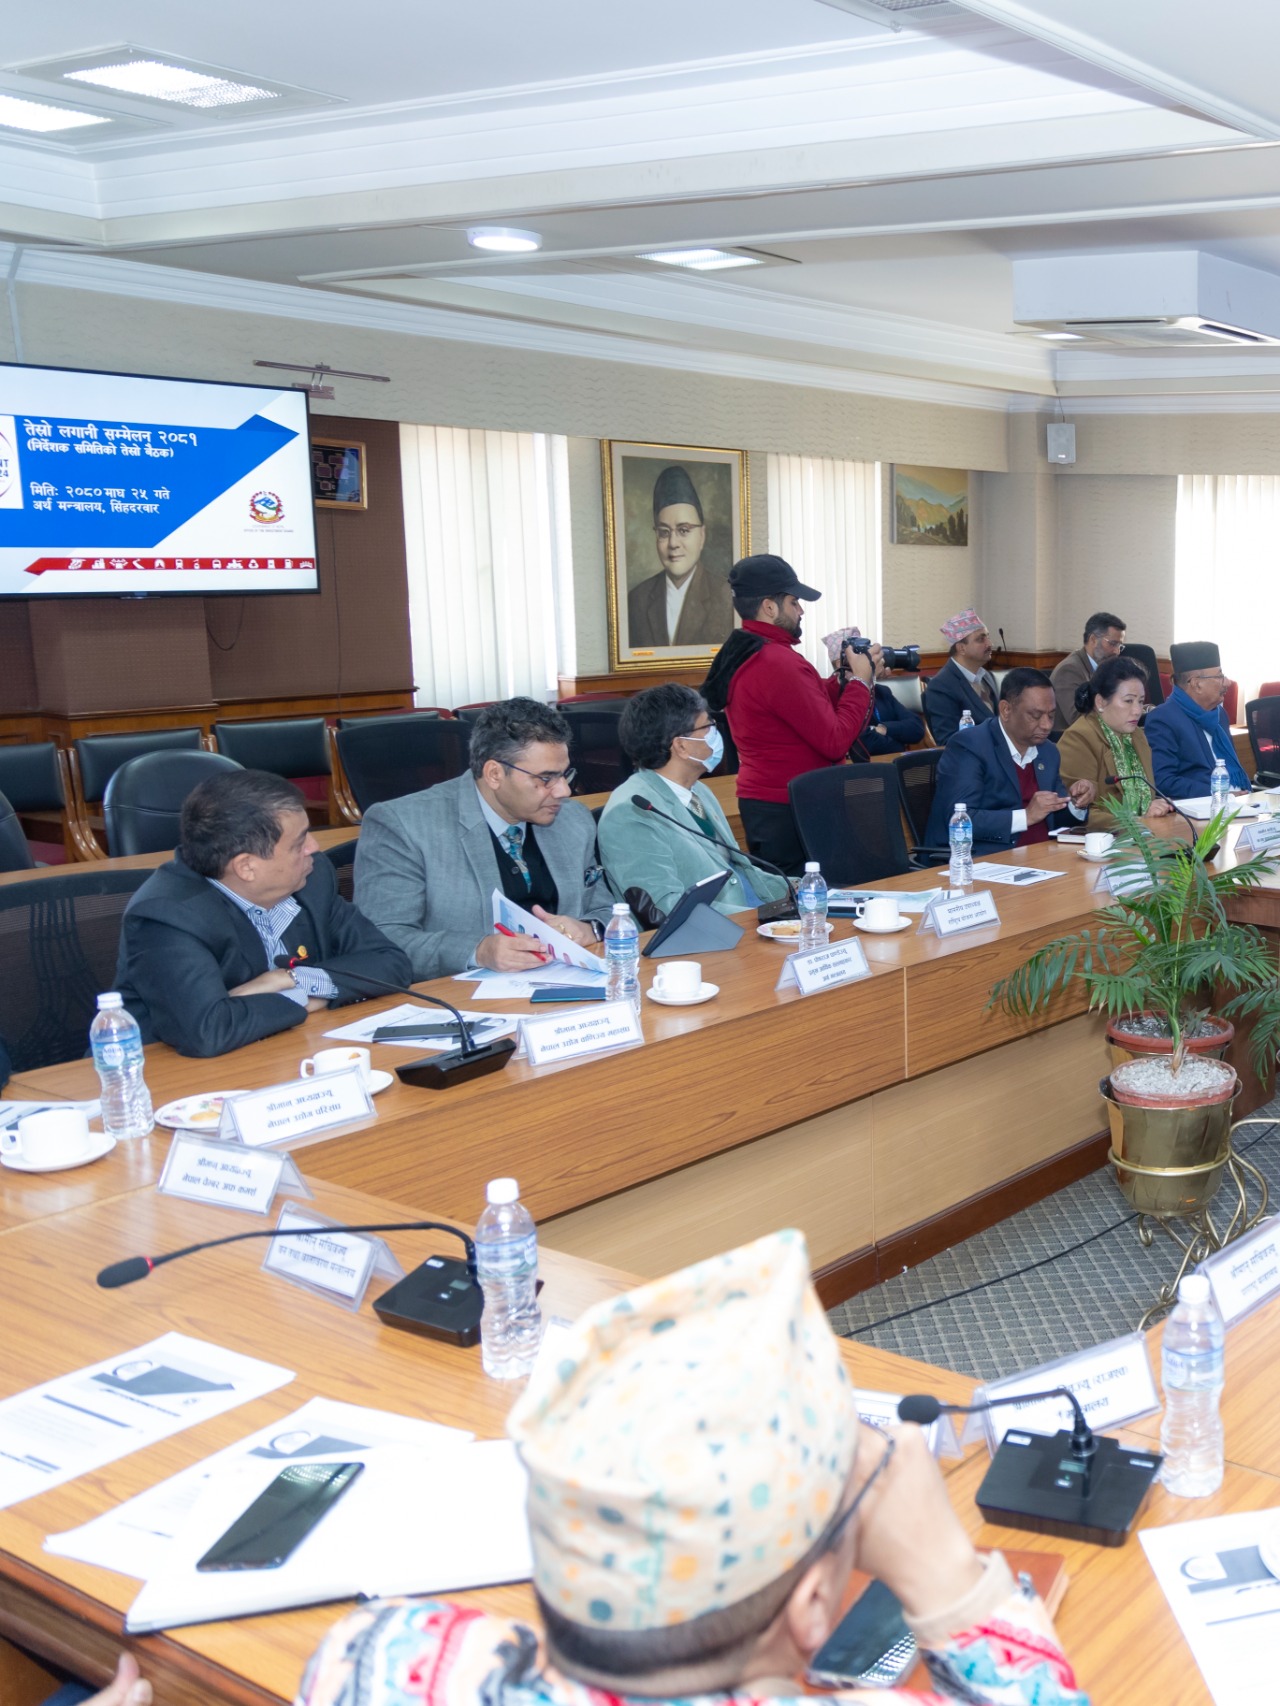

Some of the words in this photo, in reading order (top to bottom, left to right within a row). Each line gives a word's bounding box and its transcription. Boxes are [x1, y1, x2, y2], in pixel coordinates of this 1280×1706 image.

[57, 423, 99, 439] लगानी
[102, 425, 151, 443] सम्मेलन
[158, 430, 197, 446] २०८१
[65, 485, 102, 499] २०८०
[104, 487, 125, 499] माघ
[132, 488, 148, 500] २५
[153, 486, 170, 500] गते
[33, 497, 52, 511] अर्थ
